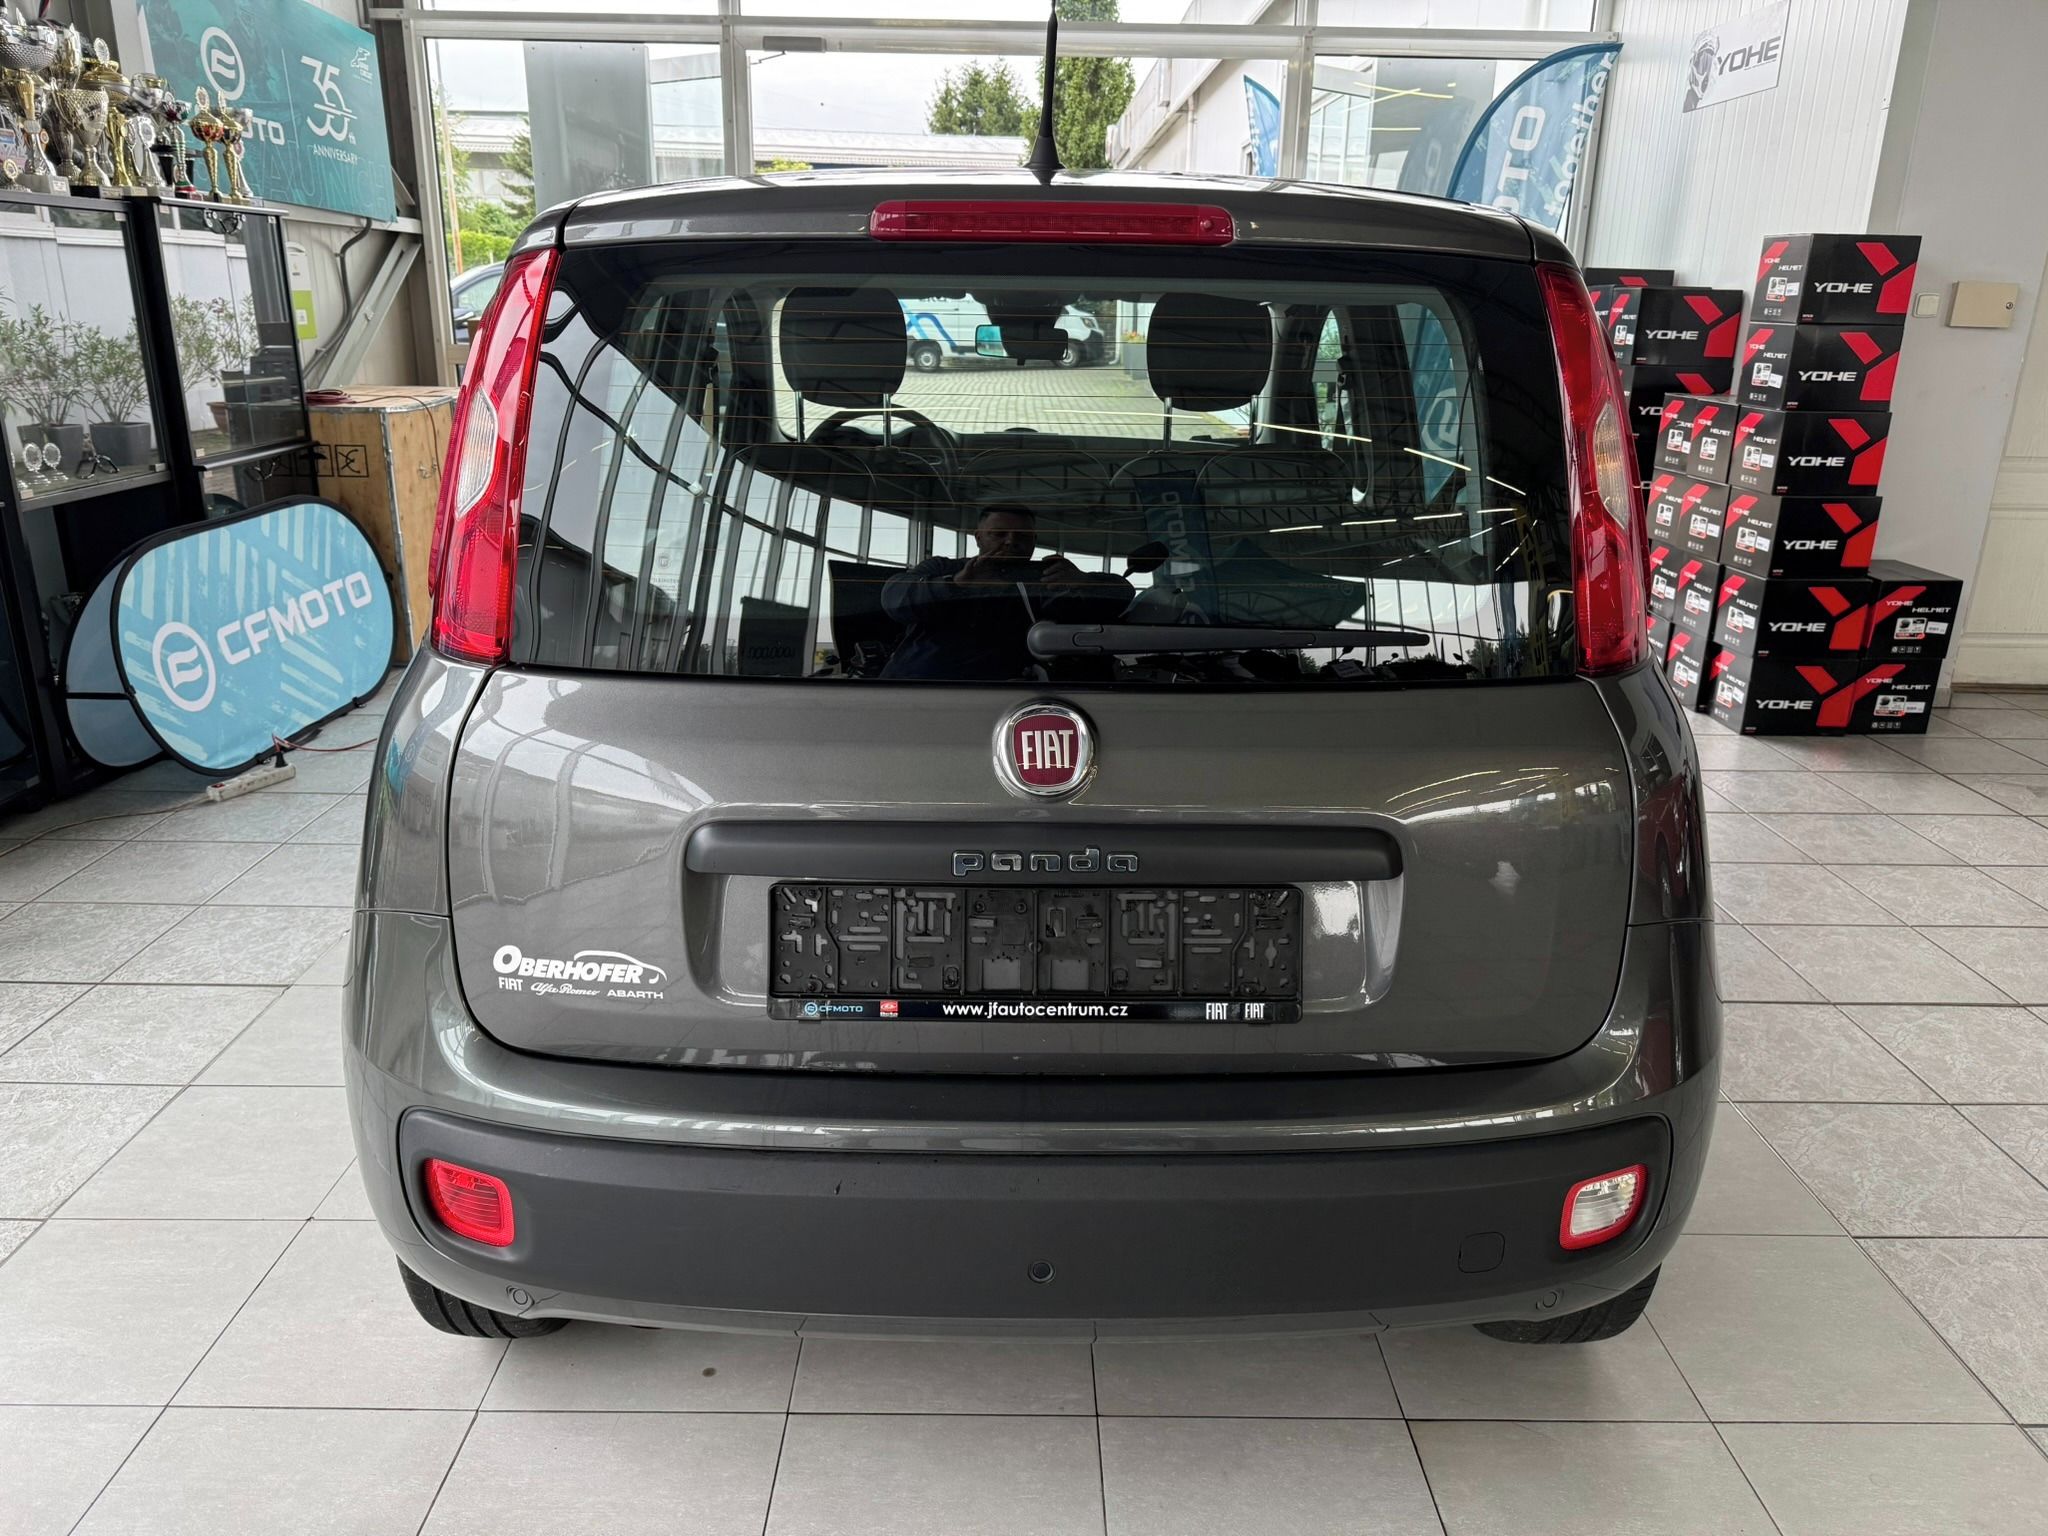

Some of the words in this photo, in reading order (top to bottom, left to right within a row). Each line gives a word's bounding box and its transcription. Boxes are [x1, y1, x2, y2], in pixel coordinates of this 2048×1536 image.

[1717, 36, 1781, 76] YOHE
[313, 143, 358, 165] ANNIVERSARY
[1814, 282, 1874, 293] YOHE
[1645, 329, 1699, 340] YOHE
[1798, 371, 1857, 382] YOHE
[1638, 406, 1663, 416] YO
[1710, 428, 1732, 436] HELMET
[1752, 436, 1777, 445] HELMET
[1787, 456, 1846, 467] YOHE
[1732, 507, 1750, 516] YOHE
[1747, 518, 1773, 528] HELMET
[1783, 540, 1839, 550] YOHE
[216, 570, 373, 665] CFMOTO
[1768, 622, 1826, 632] YOHE
[1755, 699, 1813, 710] YOHE
[1021, 730, 1074, 770] FIAT
[952, 848, 1139, 877] panda
[492, 944, 643, 984] OBERHOFER
[498, 976, 523, 992] FIAT
[530, 982, 558, 996] Alfa
[559, 983, 601, 996] Romeo
[606, 989, 664, 999] ABARTH
[818, 1004, 864, 1013] CFMOTO
[942, 1002, 1129, 1018] www.jfautocentrum.cz
[1205, 1003, 1229, 1020] FIAT
[1244, 1003, 1265, 1020] FIAT
